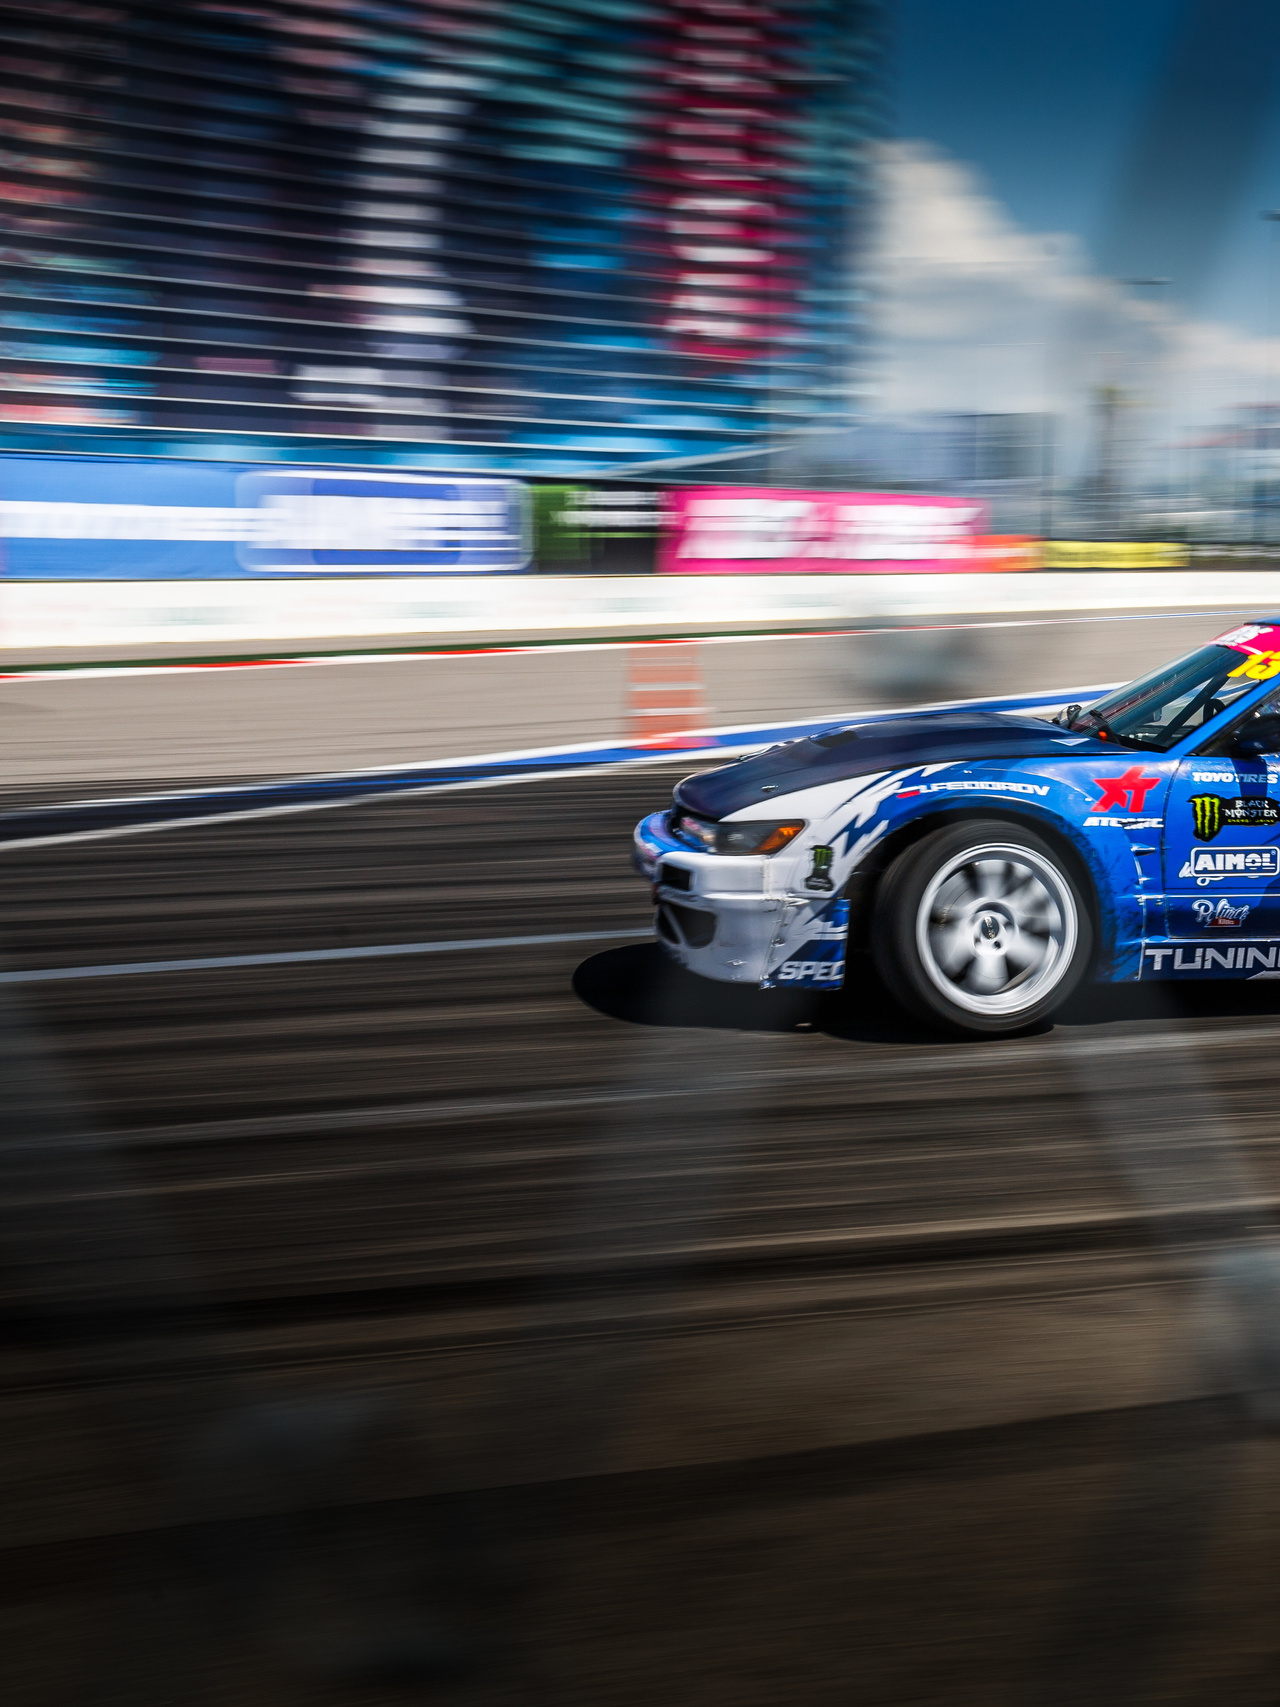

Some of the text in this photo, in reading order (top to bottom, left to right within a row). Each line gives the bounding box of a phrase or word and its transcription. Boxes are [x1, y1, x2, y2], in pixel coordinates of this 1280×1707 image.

[1192, 771, 1279, 785] TOYO TIRES
[1235, 799, 1270, 809] BLACK
[1221, 807, 1278, 819] MONSTER
[1194, 852, 1276, 871] AIMOL
